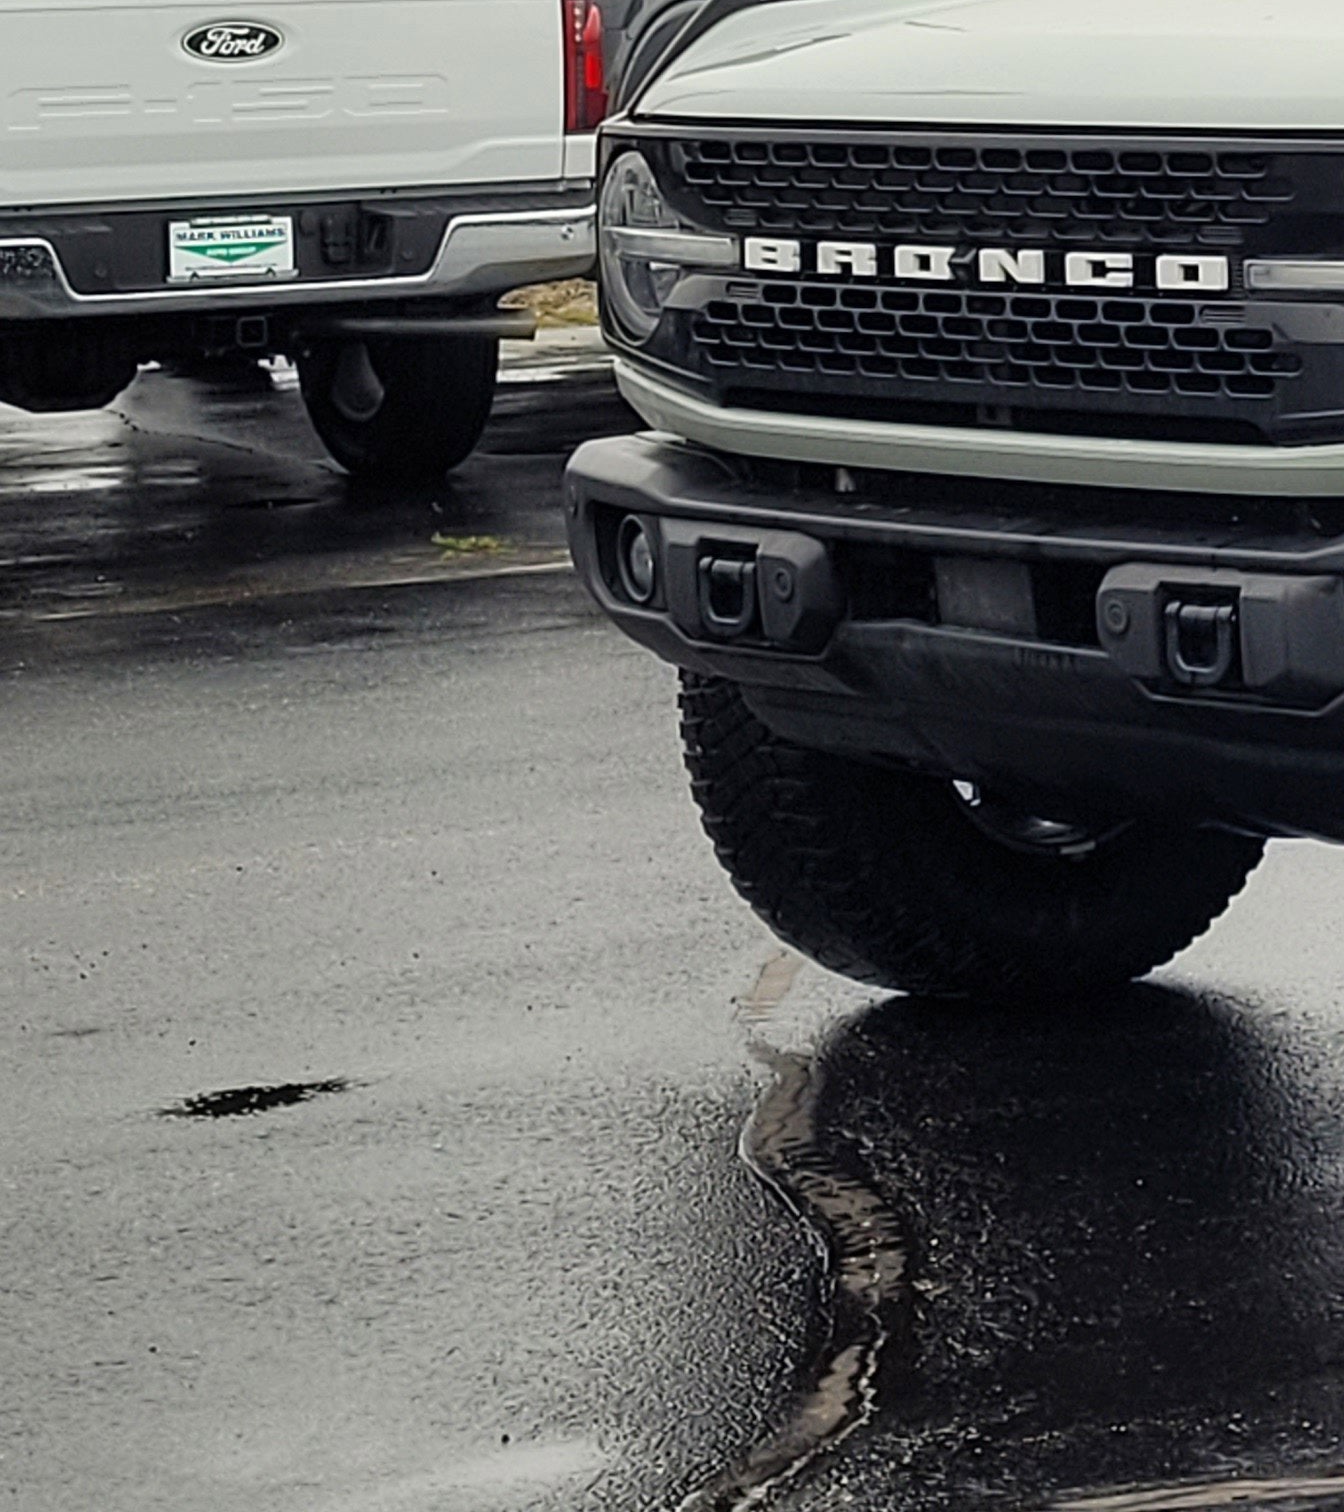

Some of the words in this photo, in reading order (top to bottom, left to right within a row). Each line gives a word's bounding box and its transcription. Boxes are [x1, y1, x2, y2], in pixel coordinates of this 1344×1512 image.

[200, 26, 266, 56] Ford
[8, 74, 448, 131] F-150
[176, 232, 215, 241] MARK
[219, 228, 286, 240] WILLIAMS
[744, 237, 1228, 290] BRONCO
